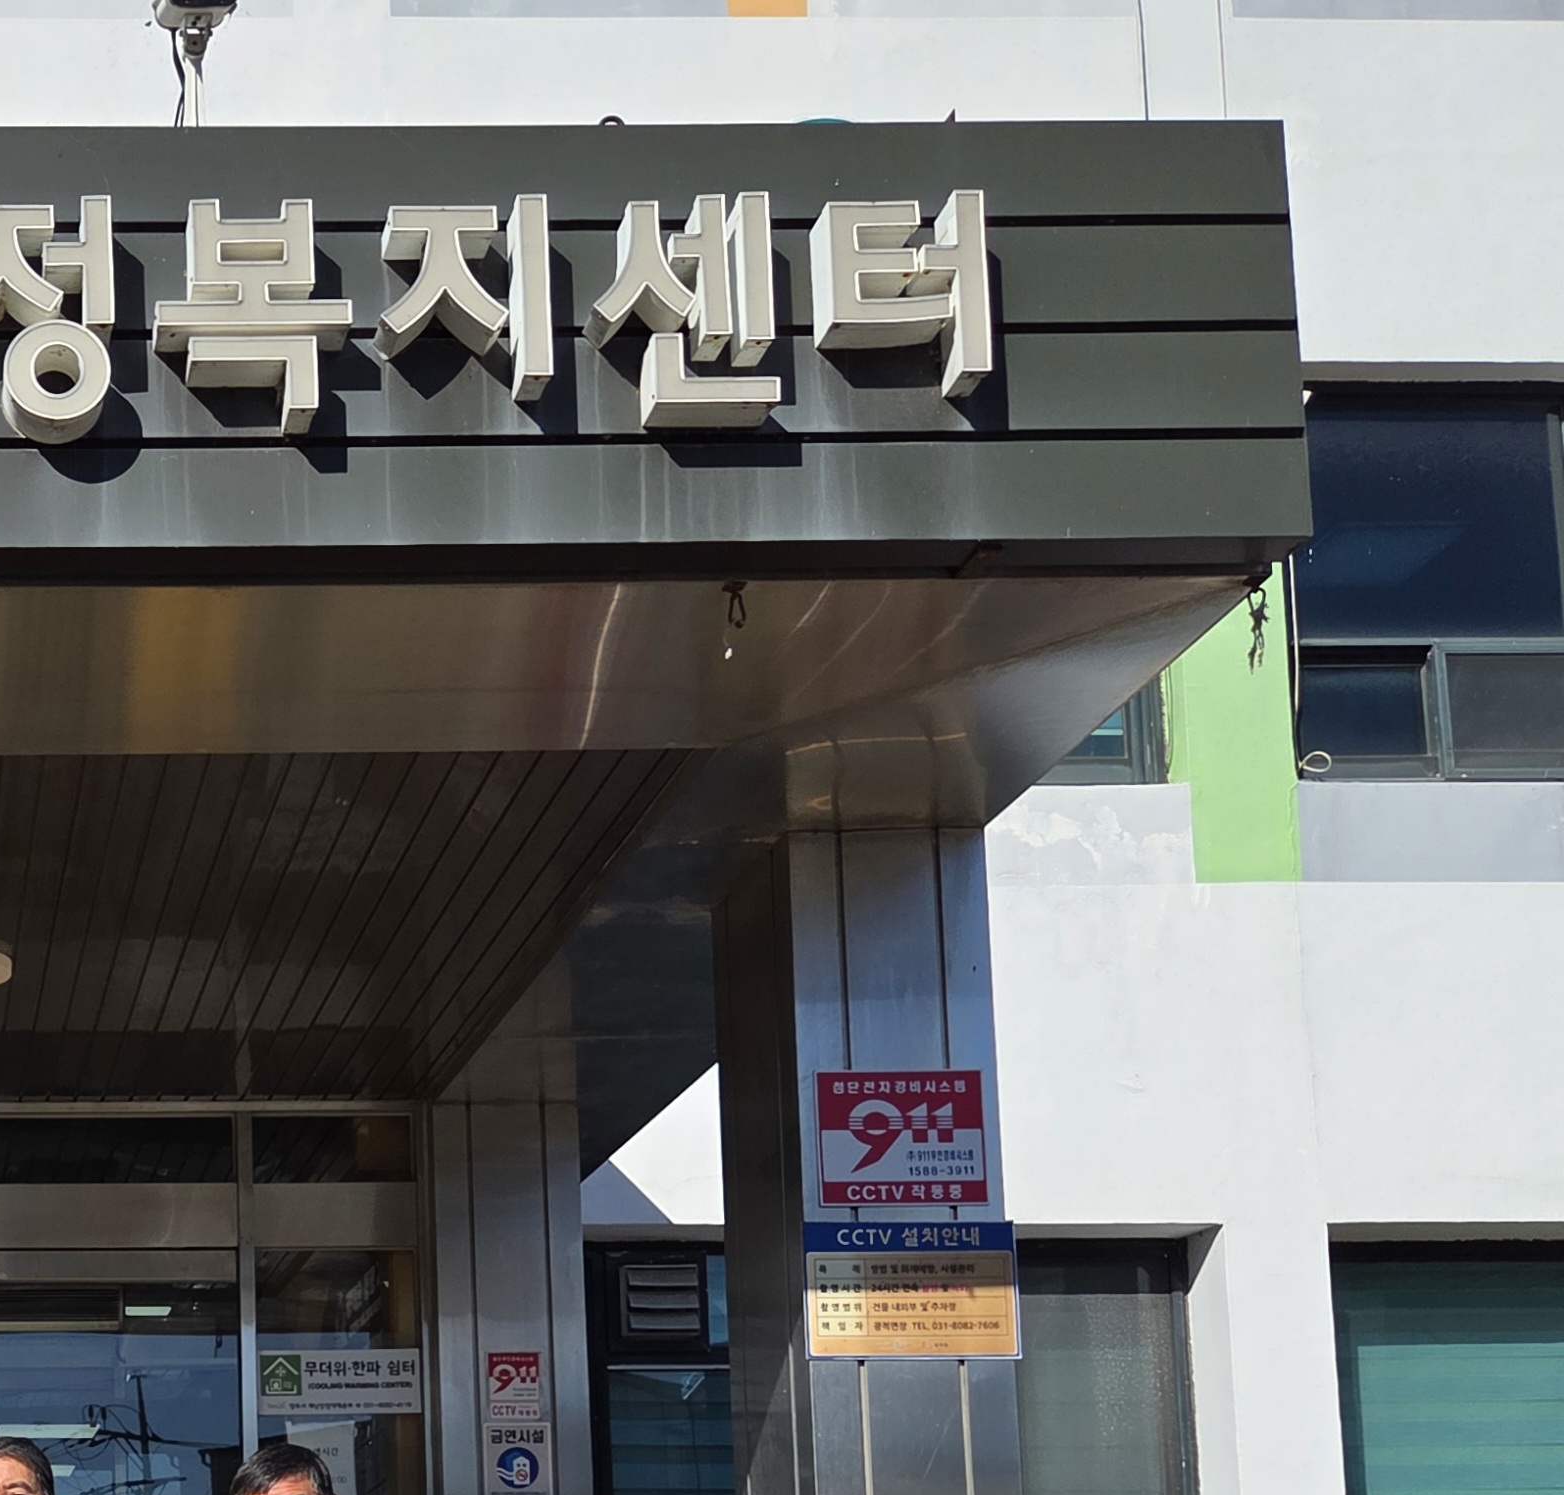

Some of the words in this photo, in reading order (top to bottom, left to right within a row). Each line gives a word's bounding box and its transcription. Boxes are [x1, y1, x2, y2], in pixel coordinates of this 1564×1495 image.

[848, 1099, 953, 1174] 911
[908, 1166, 975, 1177] 1588-3911
[847, 1185, 904, 1200] CCTV
[911, 1184, 962, 1200] 작동중
[837, 1229, 892, 1246] CCTV
[901, 1227, 980, 1247] 설치안내
[304, 1360, 381, 1377] 무더위·한파
[387, 1360, 415, 1376] 쉼터
[492, 1363, 537, 1394] 911
[492, 1405, 516, 1416] CCTV
[490, 1429, 544, 1444] 금연시설
